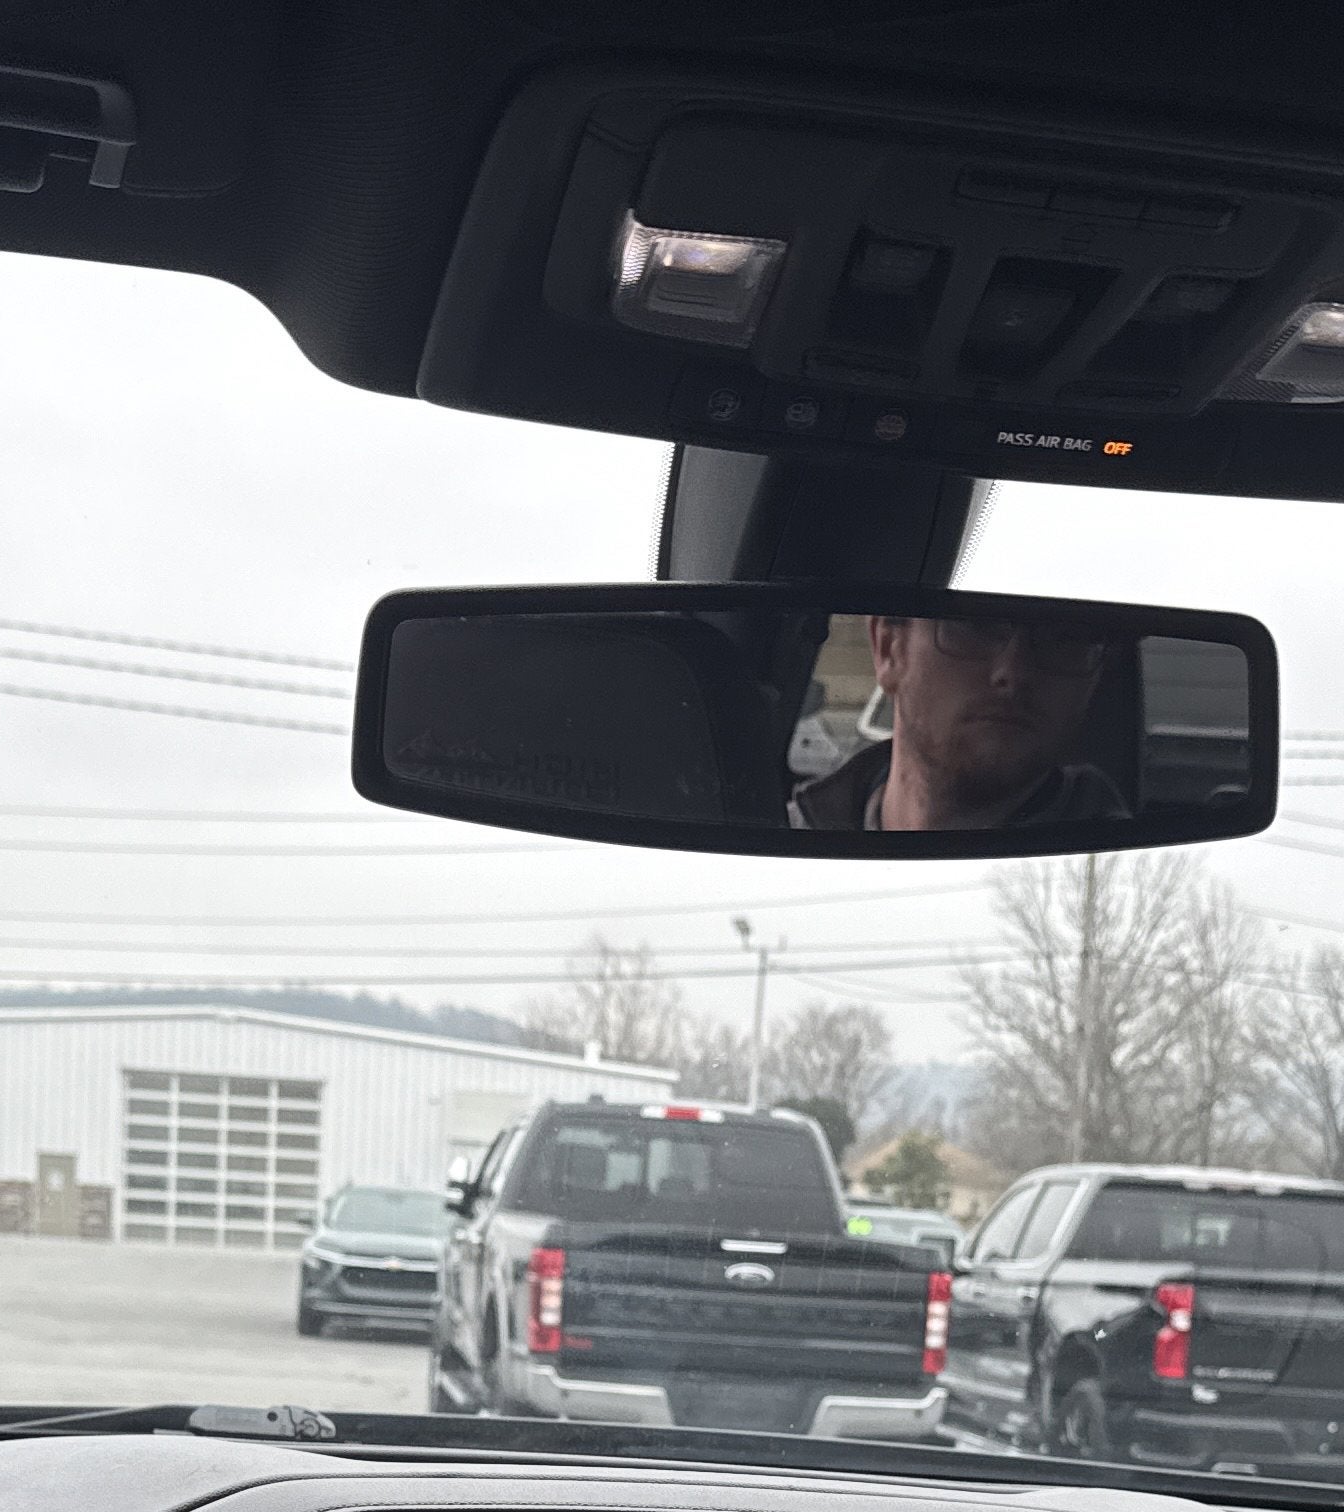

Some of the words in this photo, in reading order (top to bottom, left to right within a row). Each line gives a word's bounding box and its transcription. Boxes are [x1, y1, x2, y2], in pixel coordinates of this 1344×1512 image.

[997, 431, 1034, 446] PASS
[1035, 435, 1061, 449] AIR
[1063, 437, 1093, 451] BAG
[1104, 441, 1133, 455] OFF
